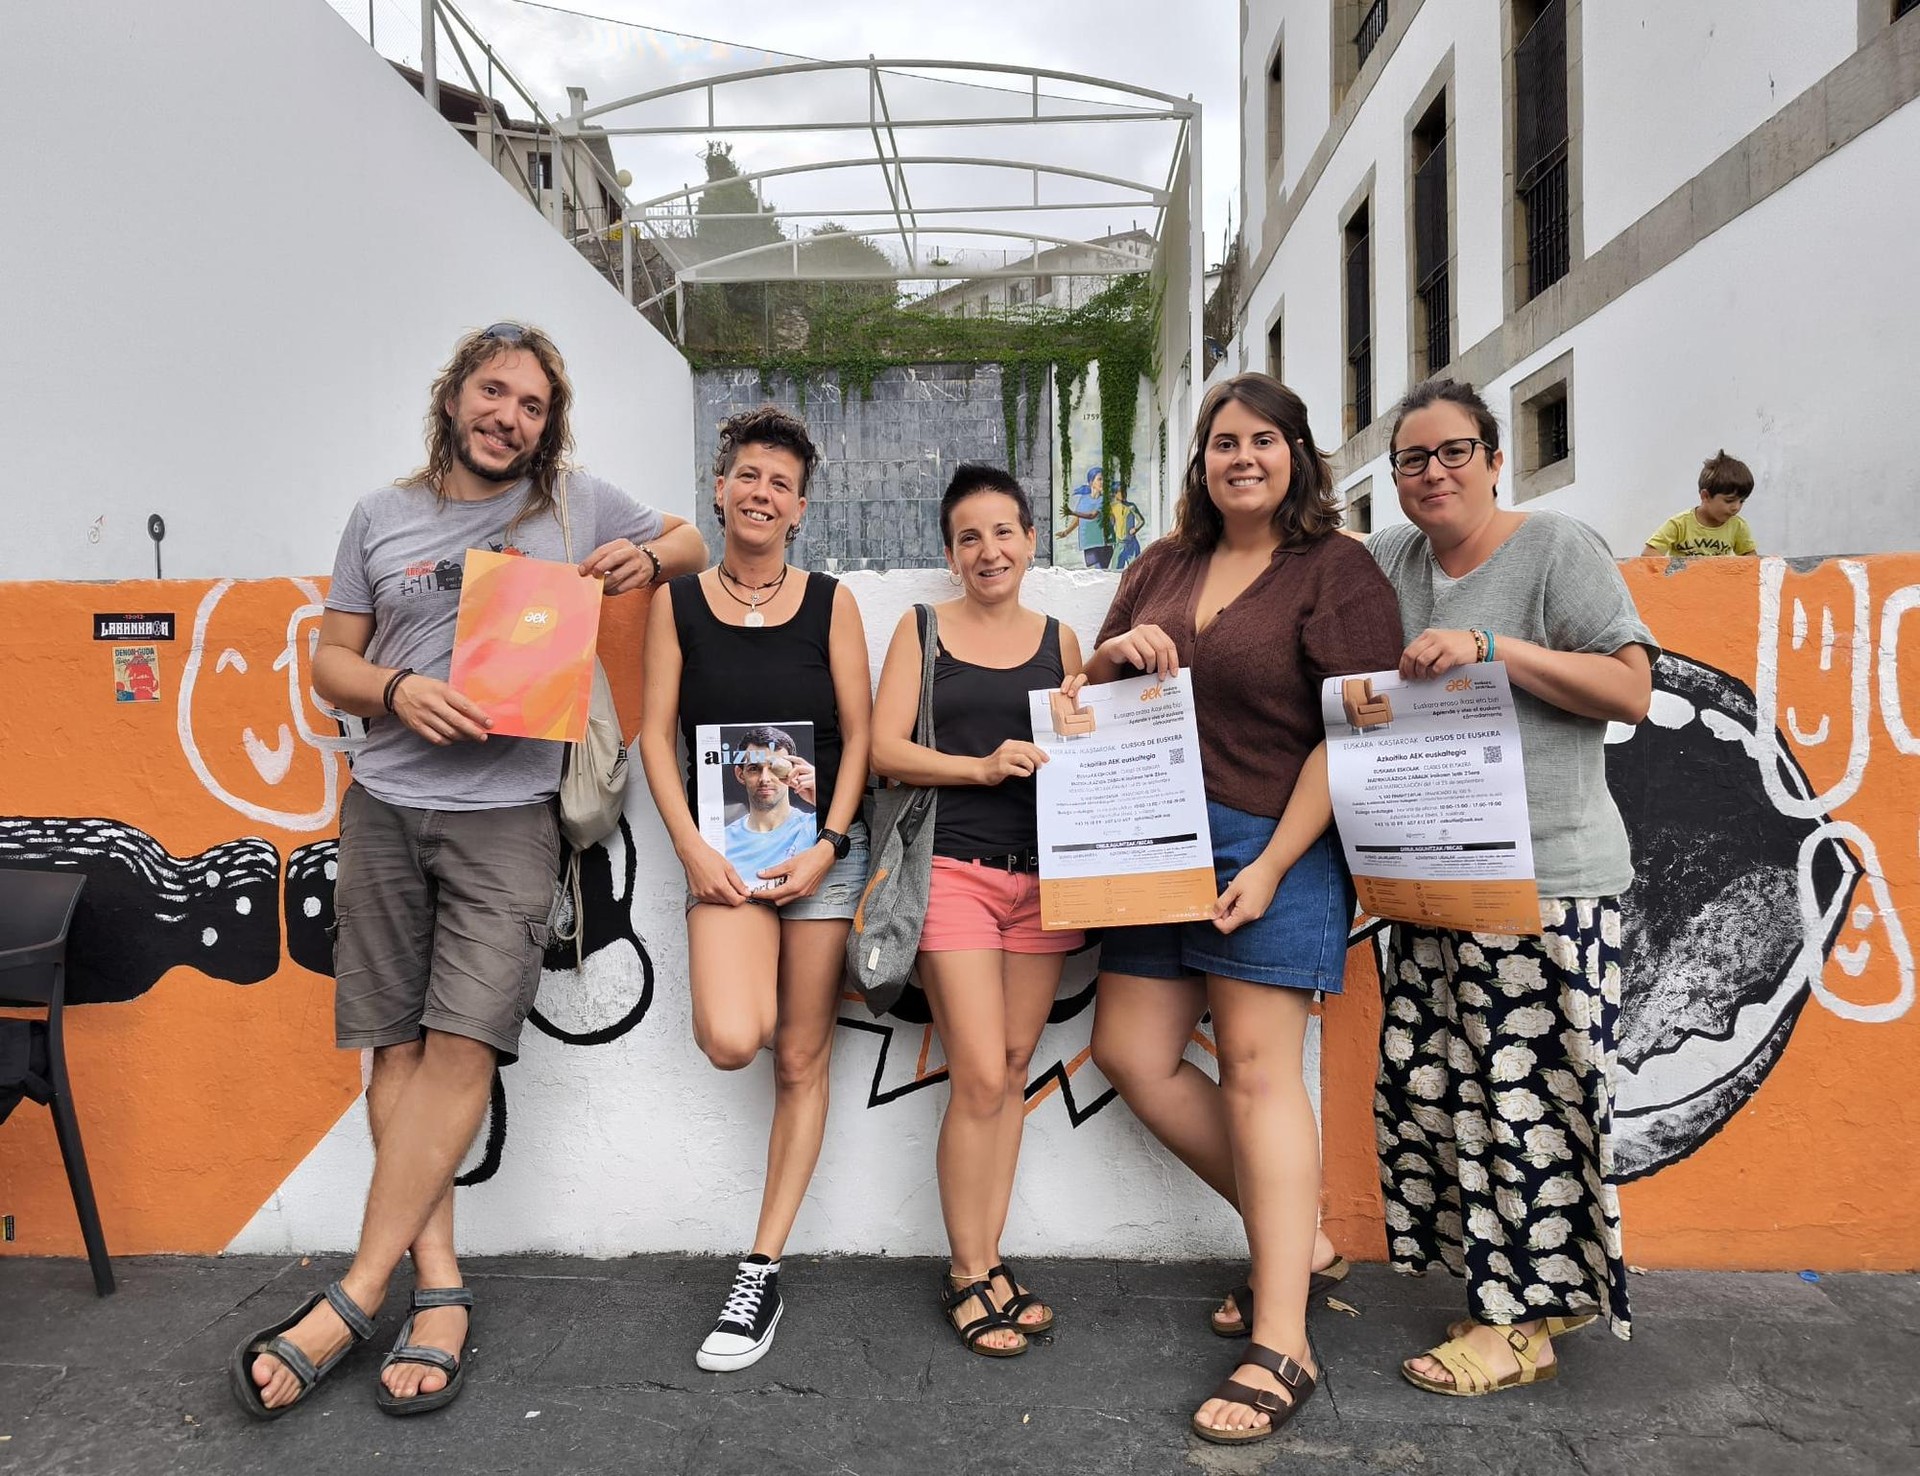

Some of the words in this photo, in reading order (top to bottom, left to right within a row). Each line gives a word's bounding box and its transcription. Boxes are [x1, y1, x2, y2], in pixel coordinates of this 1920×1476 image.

[1083, 413, 1100, 421] 1759
[524, 610, 549, 624] aek
[1445, 674, 1473, 692] aek
[1140, 683, 1162, 701] aek
[1413, 702, 1438, 710] Euskara
[1121, 740, 1146, 750] CURSOS
[1147, 738, 1155, 746] DE
[1156, 734, 1183, 744] EUSKERA
[1344, 741, 1373, 750] EUSKARA
[1378, 737, 1418, 746] IKASTAROAK
[1425, 734, 1454, 743] CURSOS
[1468, 730, 1501, 739] EUSKERA
[1377, 753, 1408, 762] Azkoitiko
[1425, 749, 1467, 758] euskaltegia
